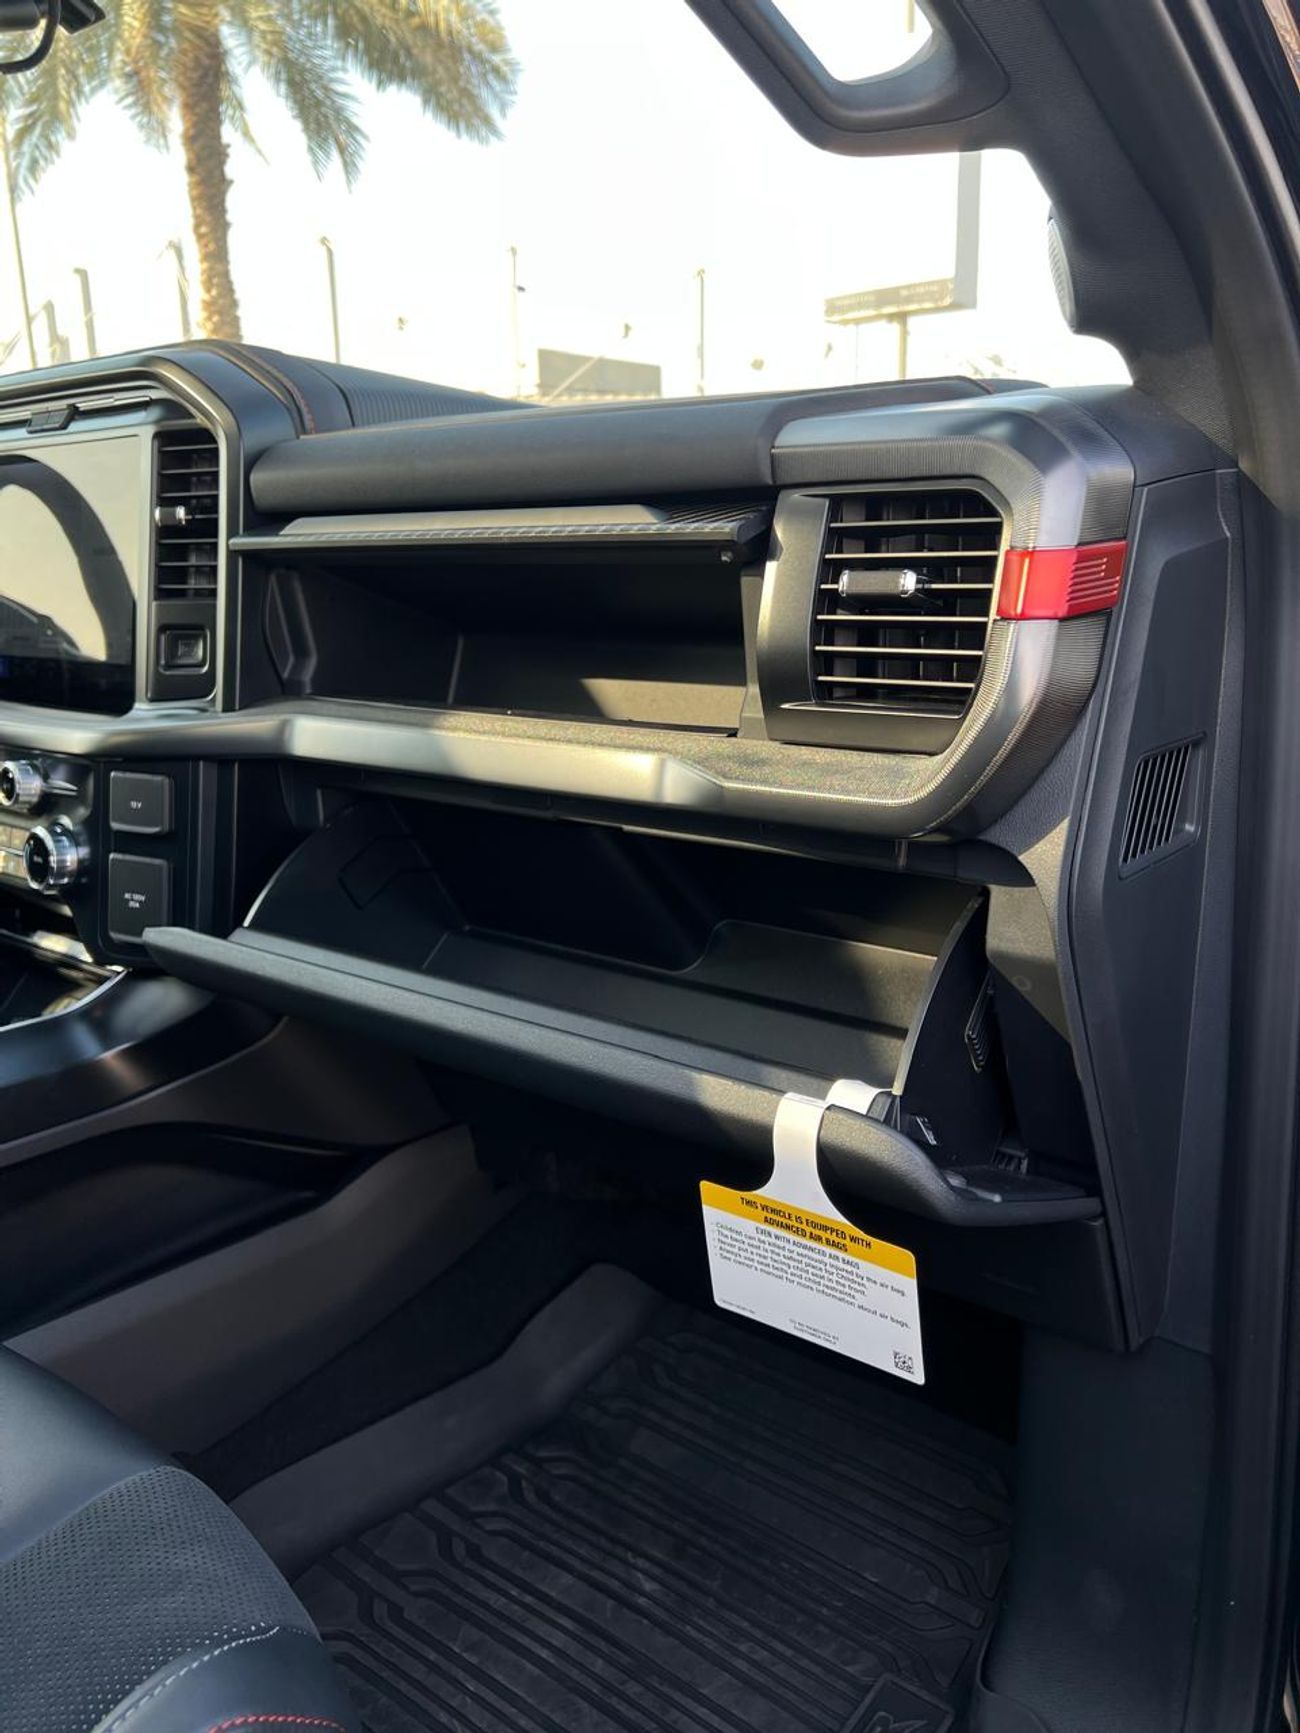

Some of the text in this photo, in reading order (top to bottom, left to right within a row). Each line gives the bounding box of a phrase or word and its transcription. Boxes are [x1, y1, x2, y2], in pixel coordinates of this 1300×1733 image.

[740, 1197, 871, 1248] THIS VEHICLE IS EQUIPPED WITH
[763, 1216, 847, 1251] ADVANCED AIR BAGS
[755, 1227, 859, 1269] EVEN WITH ADVANCED AIR BAGS
